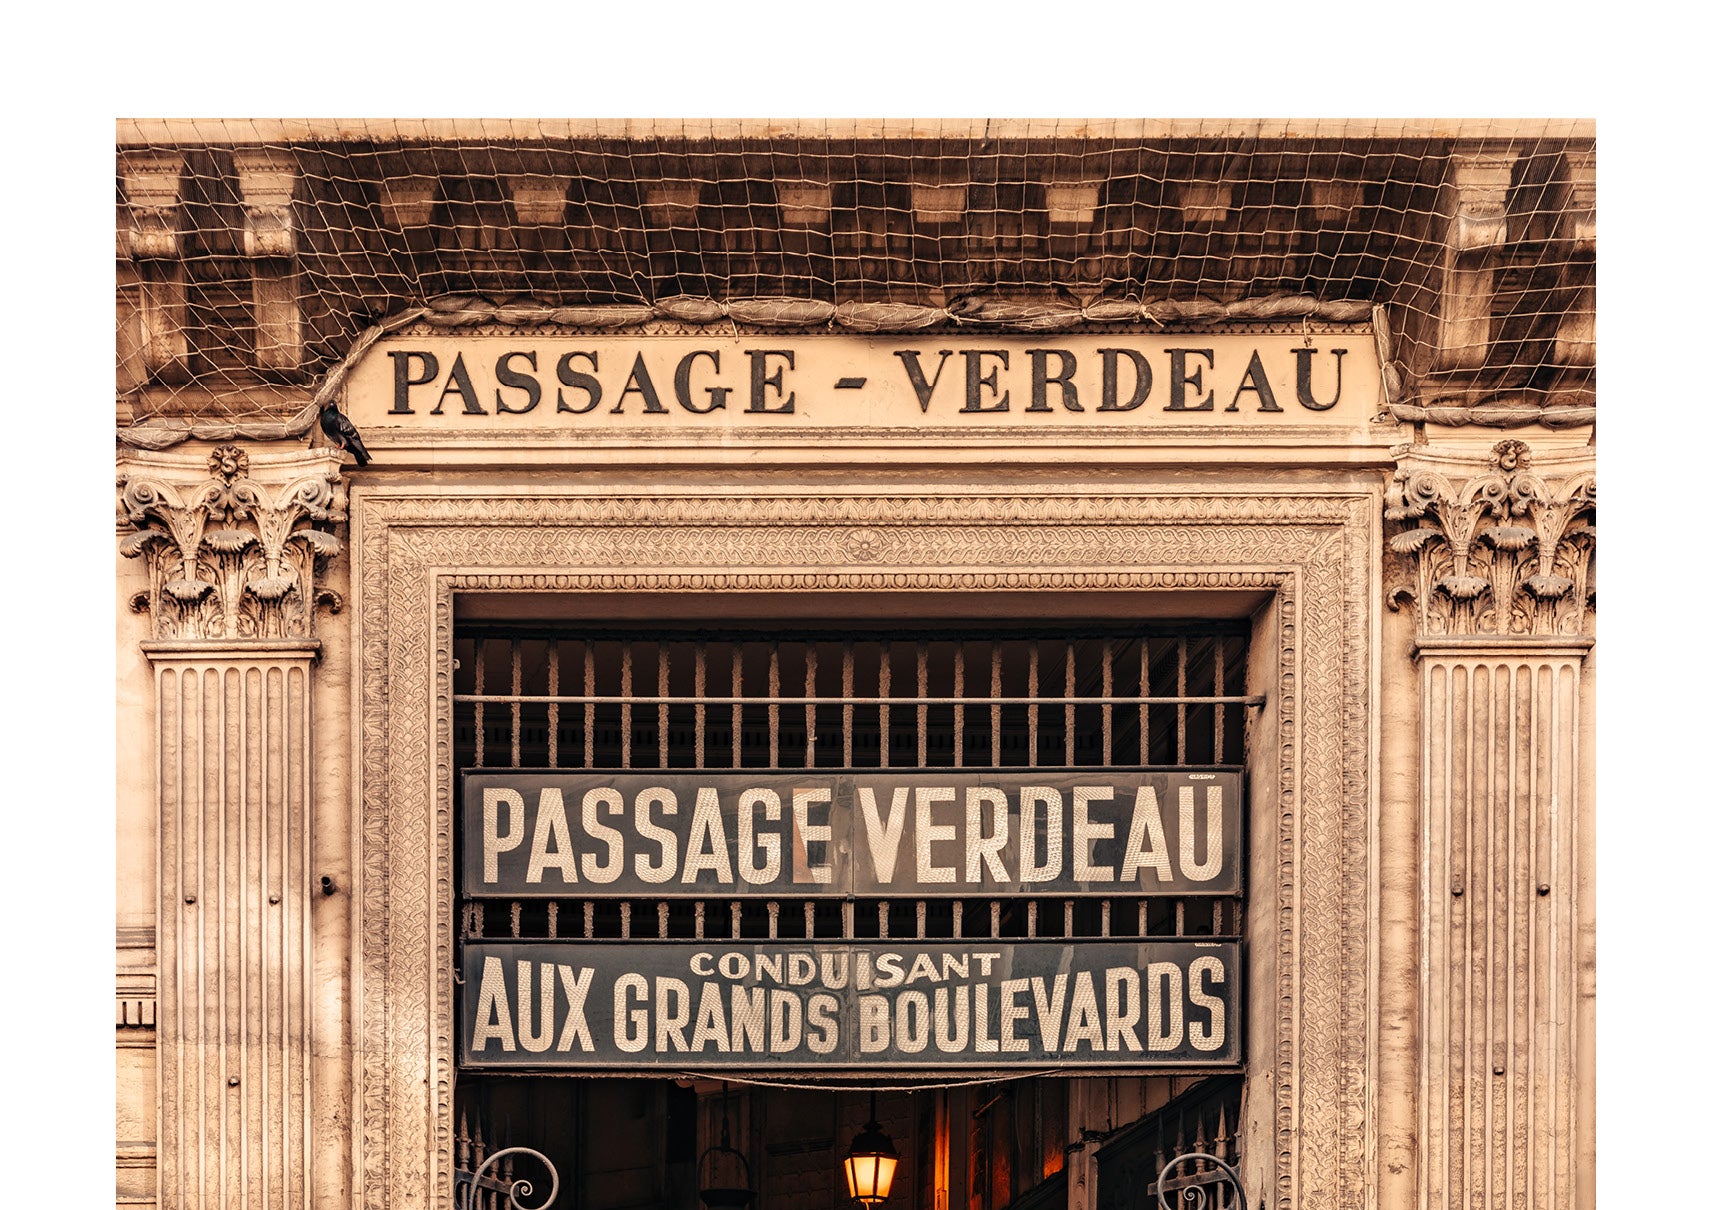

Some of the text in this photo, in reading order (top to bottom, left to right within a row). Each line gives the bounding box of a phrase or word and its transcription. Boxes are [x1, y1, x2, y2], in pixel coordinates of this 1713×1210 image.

[387, 349, 795, 415] PASSAGE
[893, 348, 1347, 413] VERDEAU
[483, 785, 1224, 884] PASSAGE VERDEAU
[471, 955, 1226, 1054] AUX GRANDS BOULEVARDS
[689, 951, 1001, 991] CONDUISANT
